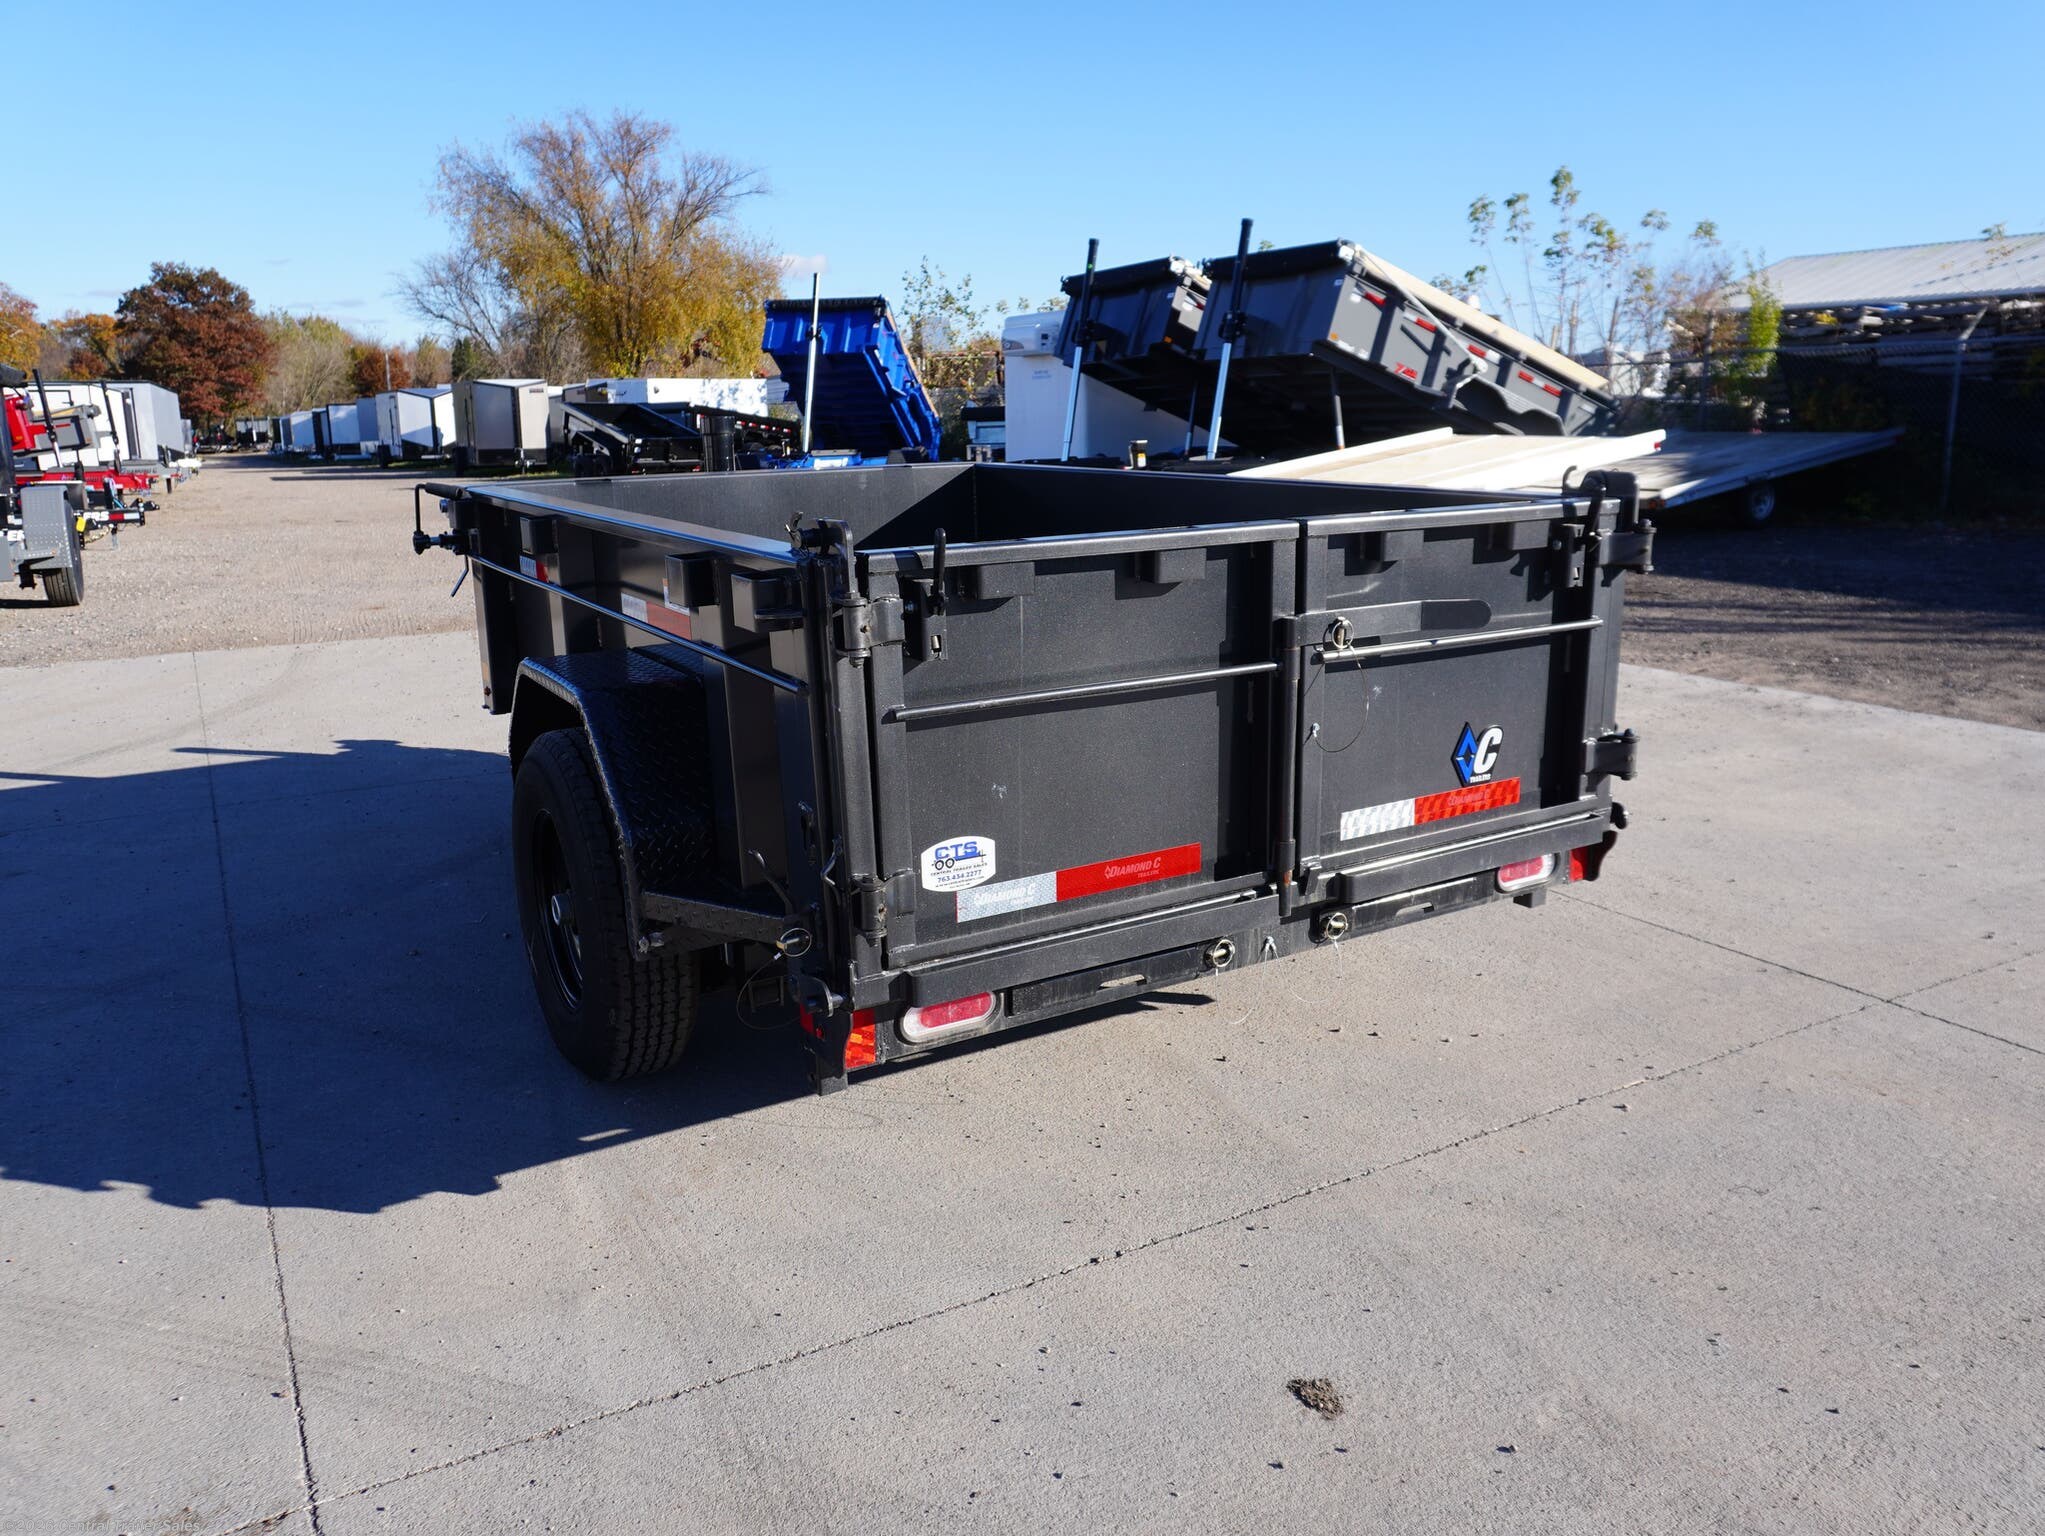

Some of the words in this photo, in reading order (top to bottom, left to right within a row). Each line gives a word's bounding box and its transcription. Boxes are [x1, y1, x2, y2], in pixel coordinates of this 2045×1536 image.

[1473, 727, 1503, 774] C
[935, 841, 978, 861] CTS
[1110, 860, 1152, 877] DIAMOND
[1153, 857, 1162, 869] C
